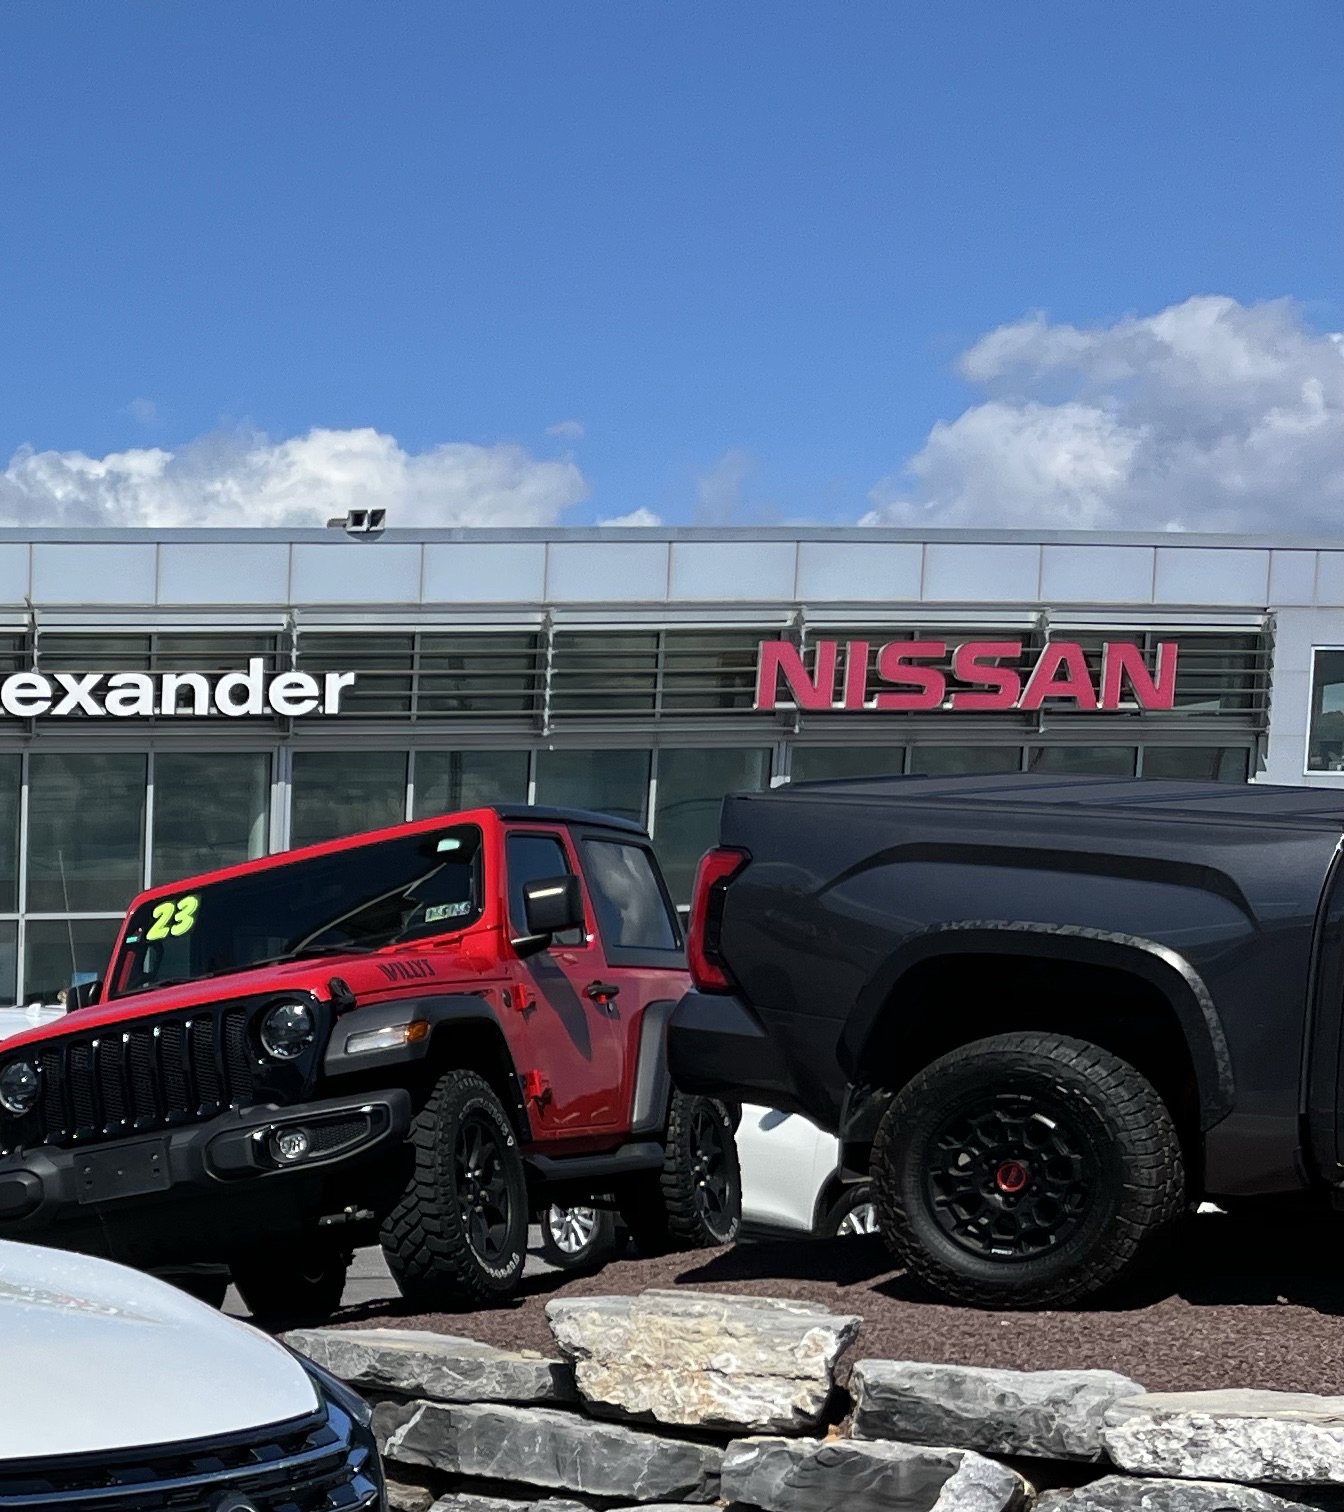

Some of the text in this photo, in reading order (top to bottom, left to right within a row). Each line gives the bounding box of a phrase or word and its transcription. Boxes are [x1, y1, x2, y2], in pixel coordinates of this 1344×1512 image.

[754, 640, 1178, 710] NISSAN
[146, 895, 198, 940] 23
[376, 959, 436, 981] WILLYS
